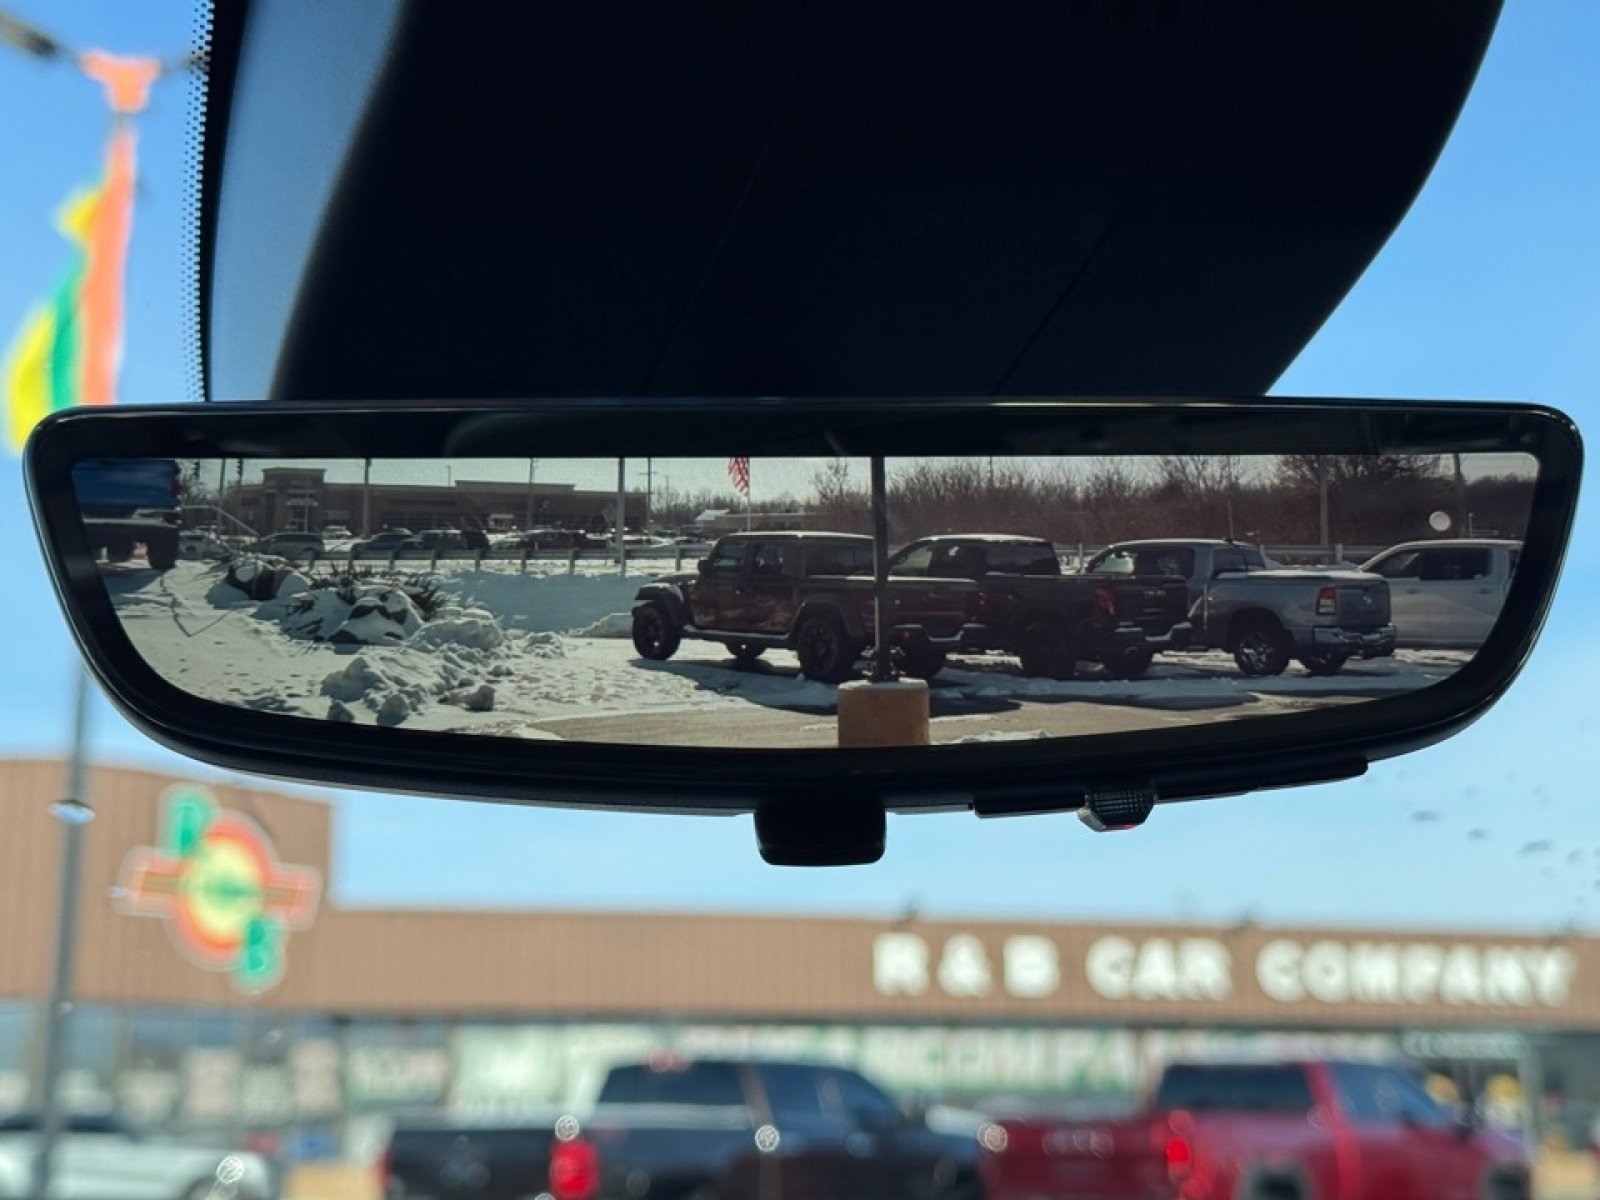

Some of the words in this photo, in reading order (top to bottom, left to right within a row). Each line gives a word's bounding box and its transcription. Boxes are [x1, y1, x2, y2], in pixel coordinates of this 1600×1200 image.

[872, 933, 929, 996] R
[938, 934, 991, 998] &
[1004, 935, 1059, 998] B
[1086, 937, 1231, 1000] CAR
[1257, 939, 1575, 1005] COMPANY
